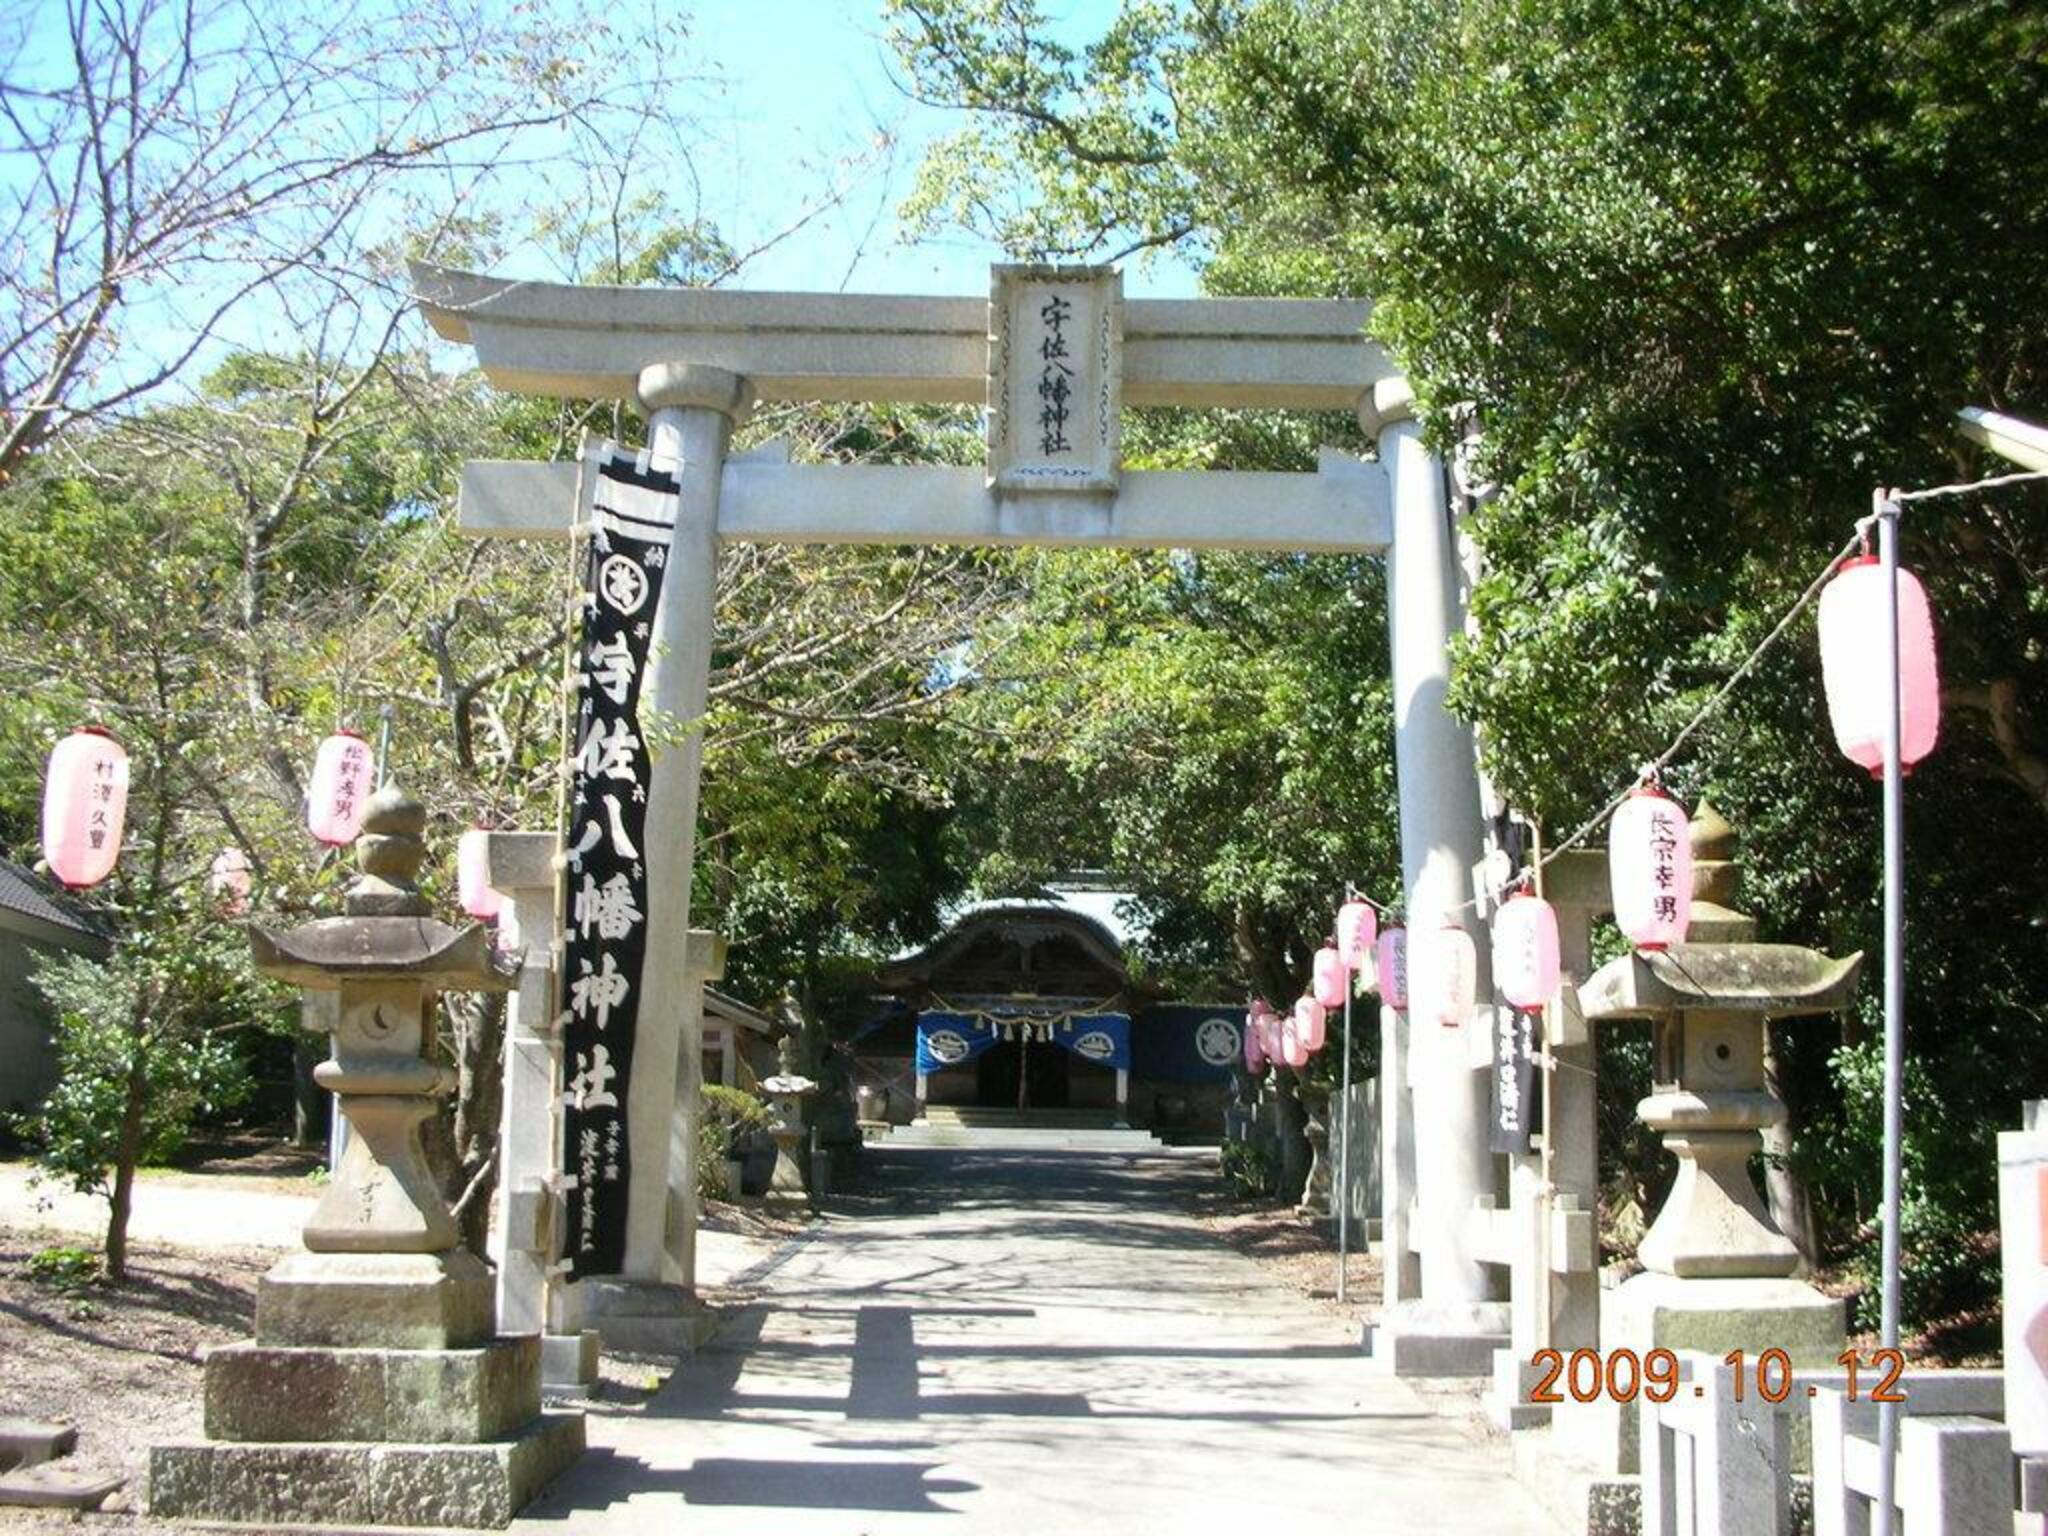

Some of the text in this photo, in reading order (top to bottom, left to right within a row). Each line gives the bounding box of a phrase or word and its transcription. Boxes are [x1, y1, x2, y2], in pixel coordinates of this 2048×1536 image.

[1037, 295, 1076, 457] 宇佐八幡神社
[569, 631, 644, 1112] 宇佐八幡神社
